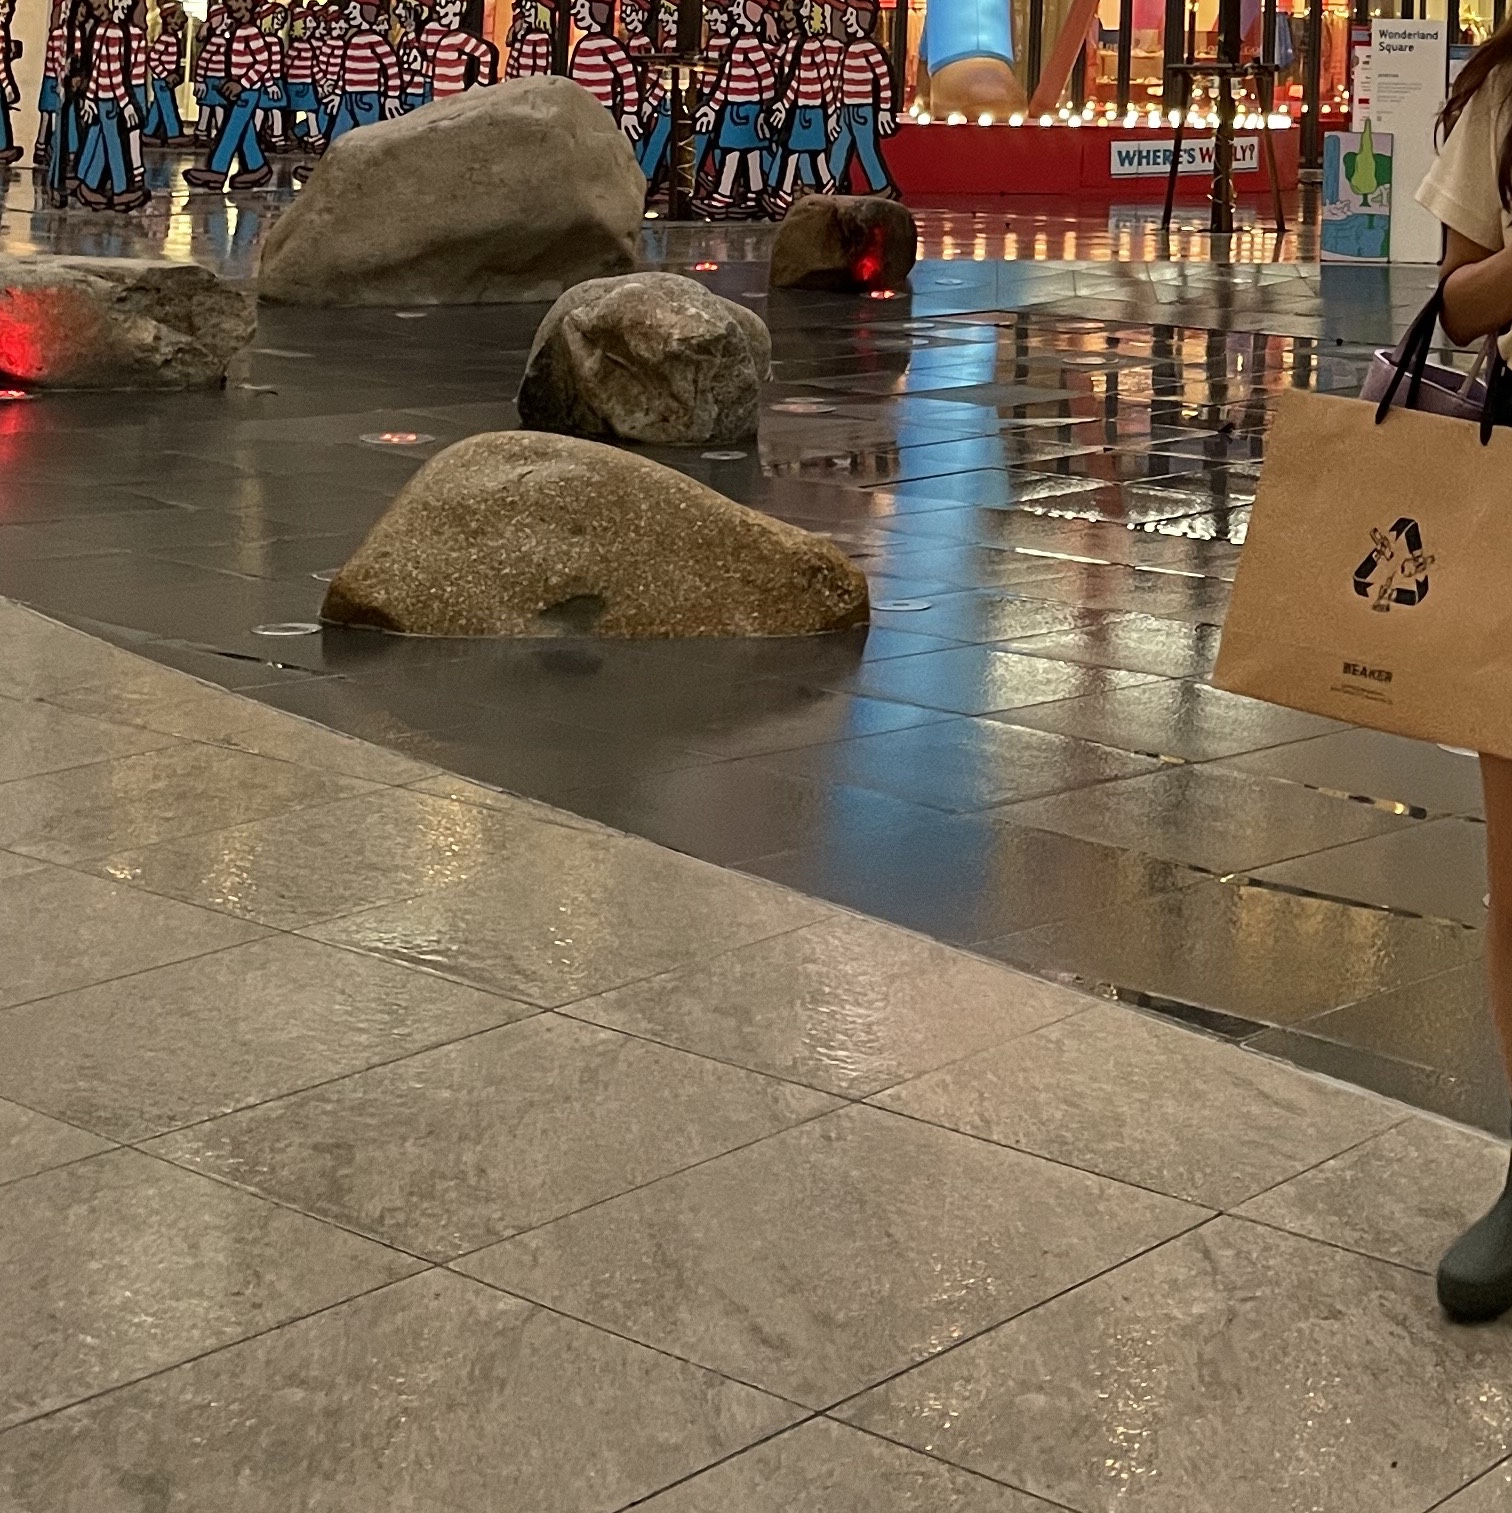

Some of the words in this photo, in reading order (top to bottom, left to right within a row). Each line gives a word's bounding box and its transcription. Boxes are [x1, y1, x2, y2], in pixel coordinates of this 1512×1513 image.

[1378, 29, 1439, 40] Wonderland
[1378, 41, 1415, 54] Square
[1199, 142, 1256, 164] WLY?
